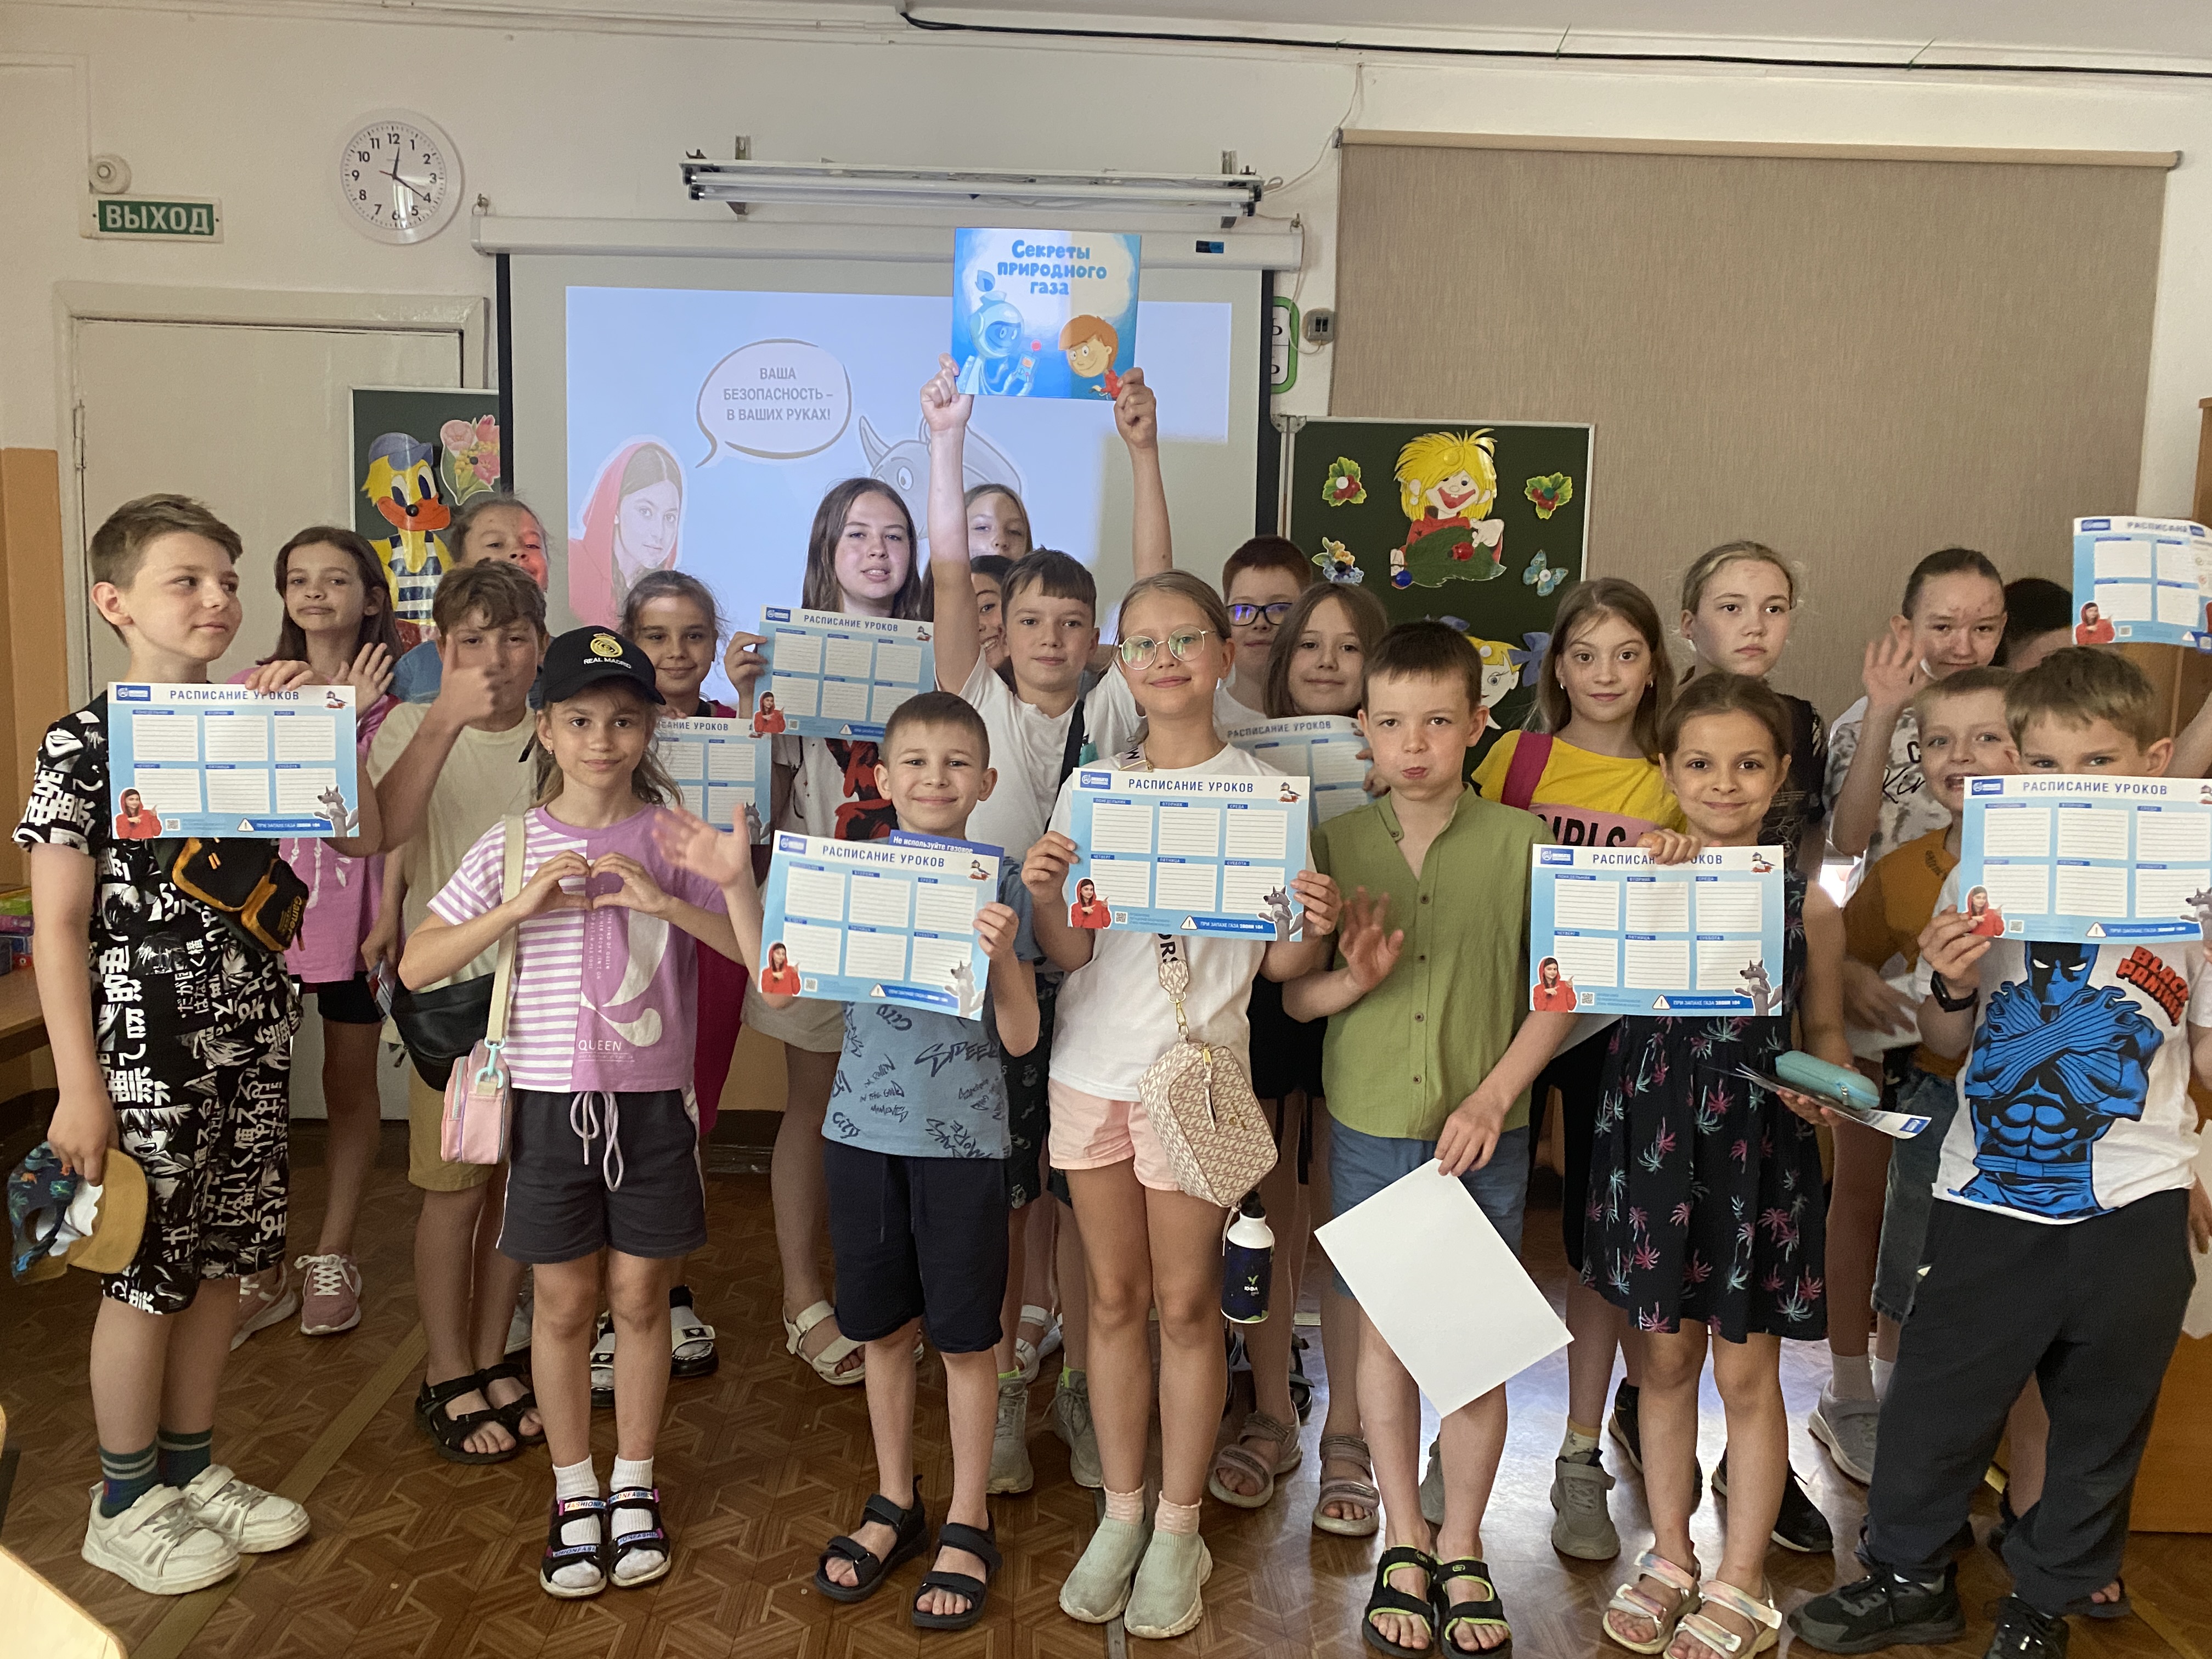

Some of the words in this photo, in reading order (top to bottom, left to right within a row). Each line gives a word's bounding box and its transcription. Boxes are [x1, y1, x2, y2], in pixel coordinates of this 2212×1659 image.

[370, 138, 380, 149] 11
[387, 133, 400, 144] 12
[410, 139, 415, 150] 1
[358, 151, 370, 162] 10
[422, 154, 431, 165] 2
[352, 170, 359, 181] 9
[430, 173, 437, 184] 3
[359, 189, 366, 200] 8
[423, 193, 431, 203] 4
[374, 204, 382, 215] 7
[392, 210, 400, 220] 6
[411, 205, 419, 216] 5
[105, 204, 210, 234] ВЫХОД
[1012, 240, 1091, 259] Секреты
[1030, 281, 1069, 295] газа
[760, 368, 796, 380] ВАША
[724, 387, 823, 400] БЕЗОПАСНОСТЬ
[727, 409, 735, 420] В
[739, 409, 783, 421] ВАШИХ
[787, 408, 831, 420] РУКАХ!
[804, 614, 861, 628] РАСПИСАНИЕ
[865, 620, 898, 632] УРОКОВ
[604, 657, 631, 669] MADRID
[170, 690, 249, 700] РАСПИСАНИЕ
[693, 723, 729, 731] УРОКОВ
[1227, 723, 1289, 738] РАСПИСАНИЕ
[1294, 721, 1331, 732] УРОКОВ
[1128, 778, 1204, 791] РАСПИСАНИЕ
[1209, 782, 1254, 793] УРОКОВ
[2023, 781, 2109, 792] РАСПИСАНИЕ
[2115, 783, 2168, 795] УРОКОВ
[893, 836, 902, 844] Не
[904, 838, 946, 850] используйте
[822, 845, 895, 862] РАСПИСАНИЕ
[901, 854, 945, 867] УРОКОВ
[1593, 854, 1655, 865] РАСПИСАН
[2130, 946, 2189, 1001] BLACK
[578, 1040, 622, 1051] QUEEN
